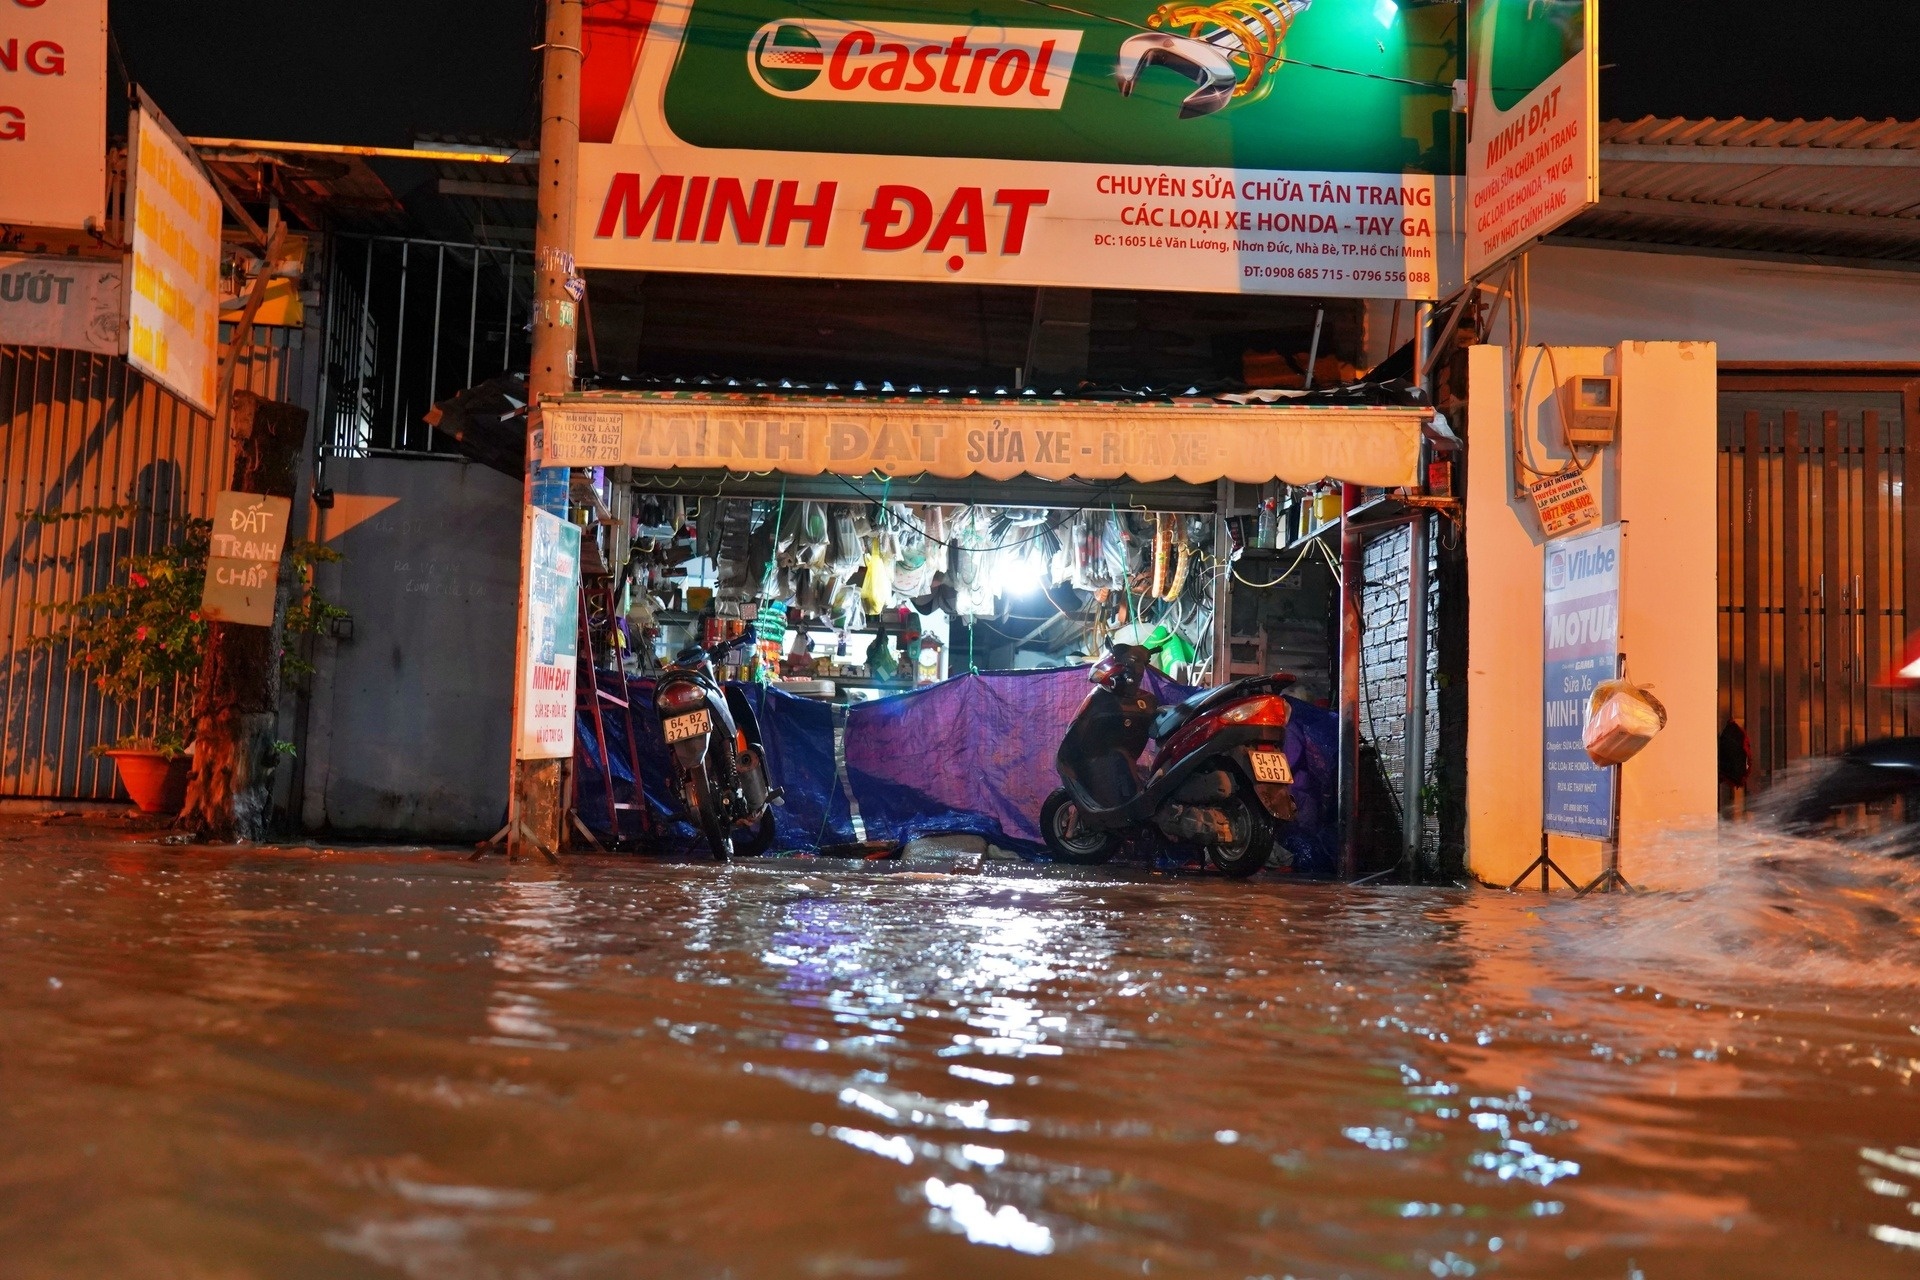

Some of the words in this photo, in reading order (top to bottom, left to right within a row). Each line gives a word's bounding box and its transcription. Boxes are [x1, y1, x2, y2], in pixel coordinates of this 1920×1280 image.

[828, 30, 1057, 97] Castrol
[1486, 114, 1525, 170] MINH
[1528, 85, 1561, 135] ĐẠT
[1474, 178, 1500, 209] CHUYÊN
[1535, 142, 1550, 165] TÂN
[1550, 120, 1577, 154] TRANG
[1096, 173, 1186, 197] CHUYÊN
[1192, 174, 1236, 199] SỬA
[1241, 178, 1304, 202] CHỮA
[1308, 180, 1350, 203] TÂN
[1356, 186, 1431, 206] TRANG
[1478, 212, 1491, 233] CÁC
[1491, 202, 1506, 224] LOẠI
[1507, 195, 1515, 215] XE
[1516, 176, 1542, 207] HONDA
[1547, 163, 1560, 185] TAY
[1561, 154, 1573, 175] GA
[596, 172, 838, 248] MINH
[861, 184, 1050, 273] ĐẠT
[1120, 203, 1164, 227] CÁC
[1170, 208, 1219, 234] LOẠI
[1225, 211, 1251, 230] XE
[1258, 212, 1338, 233] HONDA
[1355, 217, 1394, 236] TAY
[1400, 217, 1431, 237] GA
[1483, 232, 1500, 256] THAY
[1500, 219, 1520, 245] NHỚT
[1520, 206, 1543, 232] CHÍNH
[1094, 234, 1115, 246] ĐC:
[1118, 236, 1146, 247] 1605
[1150, 237, 1162, 248] Lê
[1165, 237, 1187, 249] Văn
[1190, 238, 1229, 253] Lương,
[1232, 240, 1264, 252] Nhơn
[1267, 241, 1292, 254] Đức,
[1296, 242, 1319, 254] Nhà
[1322, 243, 1339, 256] Bè,
[1380, 246, 1399, 257] Chí
[1402, 246, 1431, 258] Minh
[1244, 265, 1263, 277] ĐT:
[1265, 267, 1294, 278] 0908
[1297, 268, 1319, 279] 685
[1322, 269, 1343, 280] 715
[1353, 270, 1382, 281] 0796
[1384, 271, 1406, 282] 556
[1408, 272, 1431, 283] 088
[637, 416, 804, 461] MINH
[826, 421, 948, 471] ĐẠT
[967, 419, 1026, 463] SỬA
[1035, 430, 1072, 464] XE
[1102, 421, 1162, 466] RỬA
[1168, 431, 1208, 467] XE
[1554, 469, 1581, 485] INTERNET
[1561, 485, 1588, 499] CAMERA
[230, 502, 274, 534] ĐẤT
[1541, 494, 1593, 522] 0877.999.602
[213, 534, 277, 560] TRANH
[216, 563, 268, 589] CHẤP
[1568, 545, 1616, 582] Vilube
[1548, 603, 1613, 650] MOTUL
[532, 665, 555, 690] MINH
[555, 667, 571, 698] ĐẠT
[1564, 675, 1580, 693] Sửa
[1581, 674, 1592, 692] Xe
[1546, 698, 1578, 727] MINH
[668, 721, 709, 741] 321.78
[1255, 753, 1283, 767] 54-P1
[1259, 766, 1286, 781] 5867
